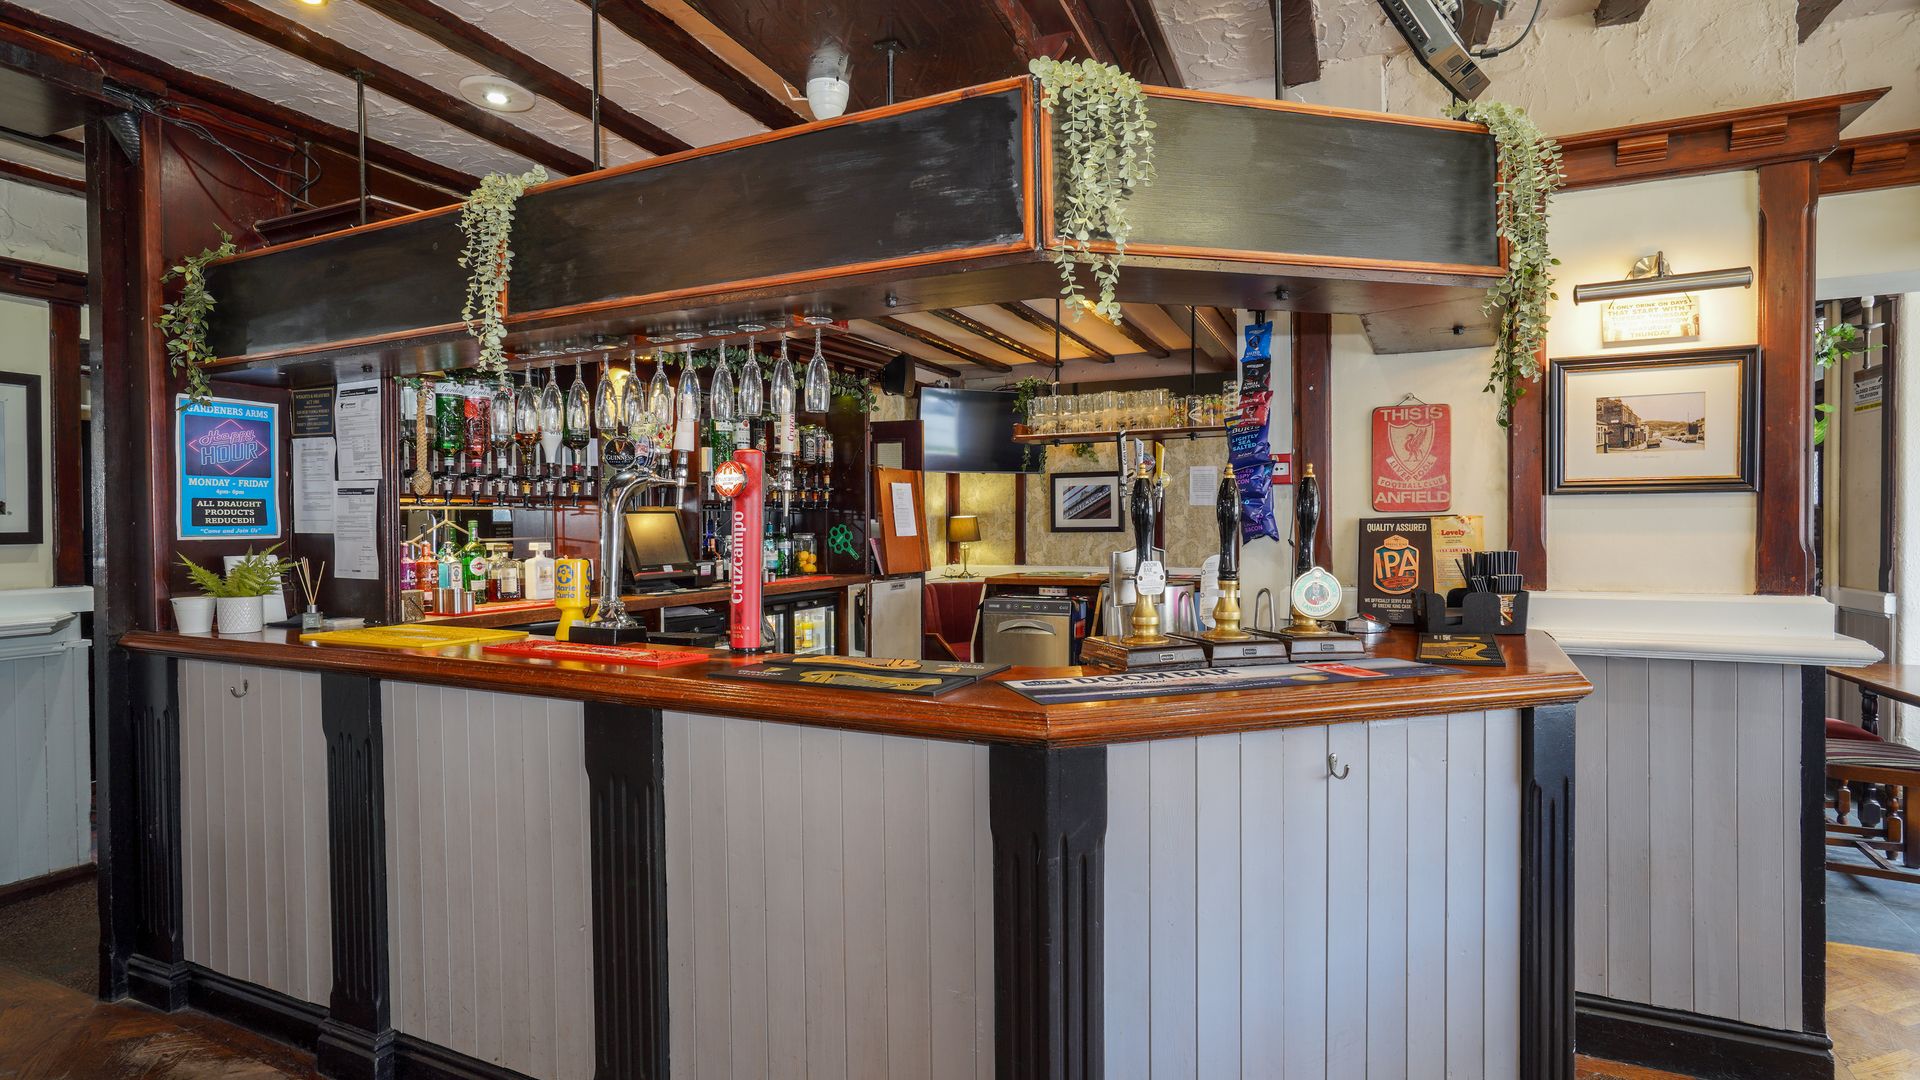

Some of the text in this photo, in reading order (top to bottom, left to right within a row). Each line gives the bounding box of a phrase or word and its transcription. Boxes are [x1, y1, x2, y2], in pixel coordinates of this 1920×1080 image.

[1636, 301, 1657, 309] DRINK
[1662, 304, 1686, 313] WITH
[187, 404, 269, 418] GARDENERS ARMS
[1380, 406, 1443, 421] THIS IS
[199, 429, 256, 446] Happy
[1232, 433, 1260, 443] LIGHTLY
[1232, 442, 1257, 452] SALTED
[201, 442, 258, 466] HOUR
[606, 454, 635, 462] GUINNESS
[188, 478, 230, 487] MONDAY
[238, 480, 270, 488] FRIDAY
[1380, 477, 1444, 489] FOOTBALL CLUB
[1374, 491, 1450, 503] ANFIELD
[217, 500, 262, 508] DRAUGHT
[204, 508, 255, 516] PRODUCTS
[1366, 523, 1427, 533] QUALITY ASSURED
[1441, 529, 1466, 537] Lovely
[731, 511, 746, 605] Cruzcampo
[1374, 549, 1418, 579] IPA
[556, 584, 576, 592] Marie
[1073, 671, 1174, 685] DOOM
[1174, 667, 1240, 679] BAR
